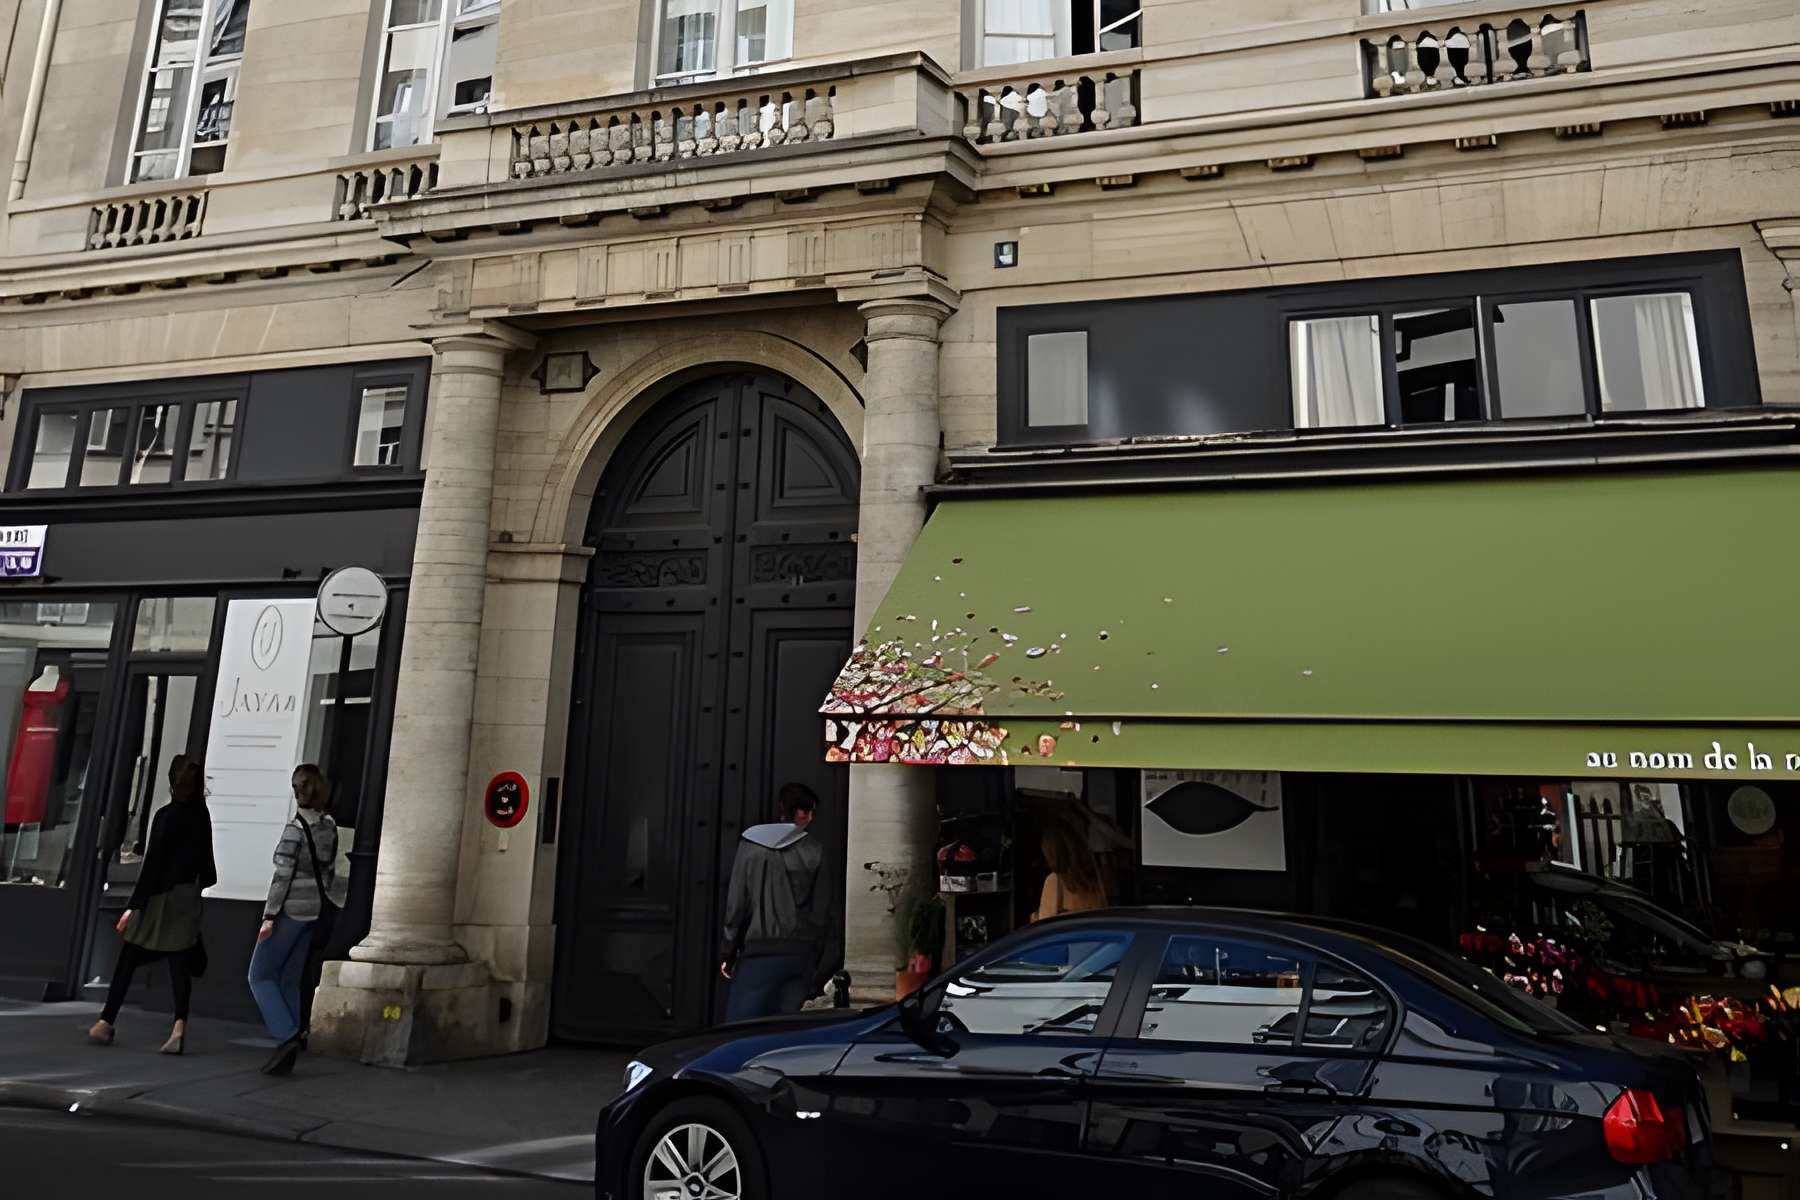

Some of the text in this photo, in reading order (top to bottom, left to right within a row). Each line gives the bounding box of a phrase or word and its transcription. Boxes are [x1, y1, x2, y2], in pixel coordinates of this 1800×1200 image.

[1586, 752, 1618, 768] au
[1629, 752, 1694, 770] nom
[1703, 740, 1738, 771] de
[1747, 741, 1773, 771] la
